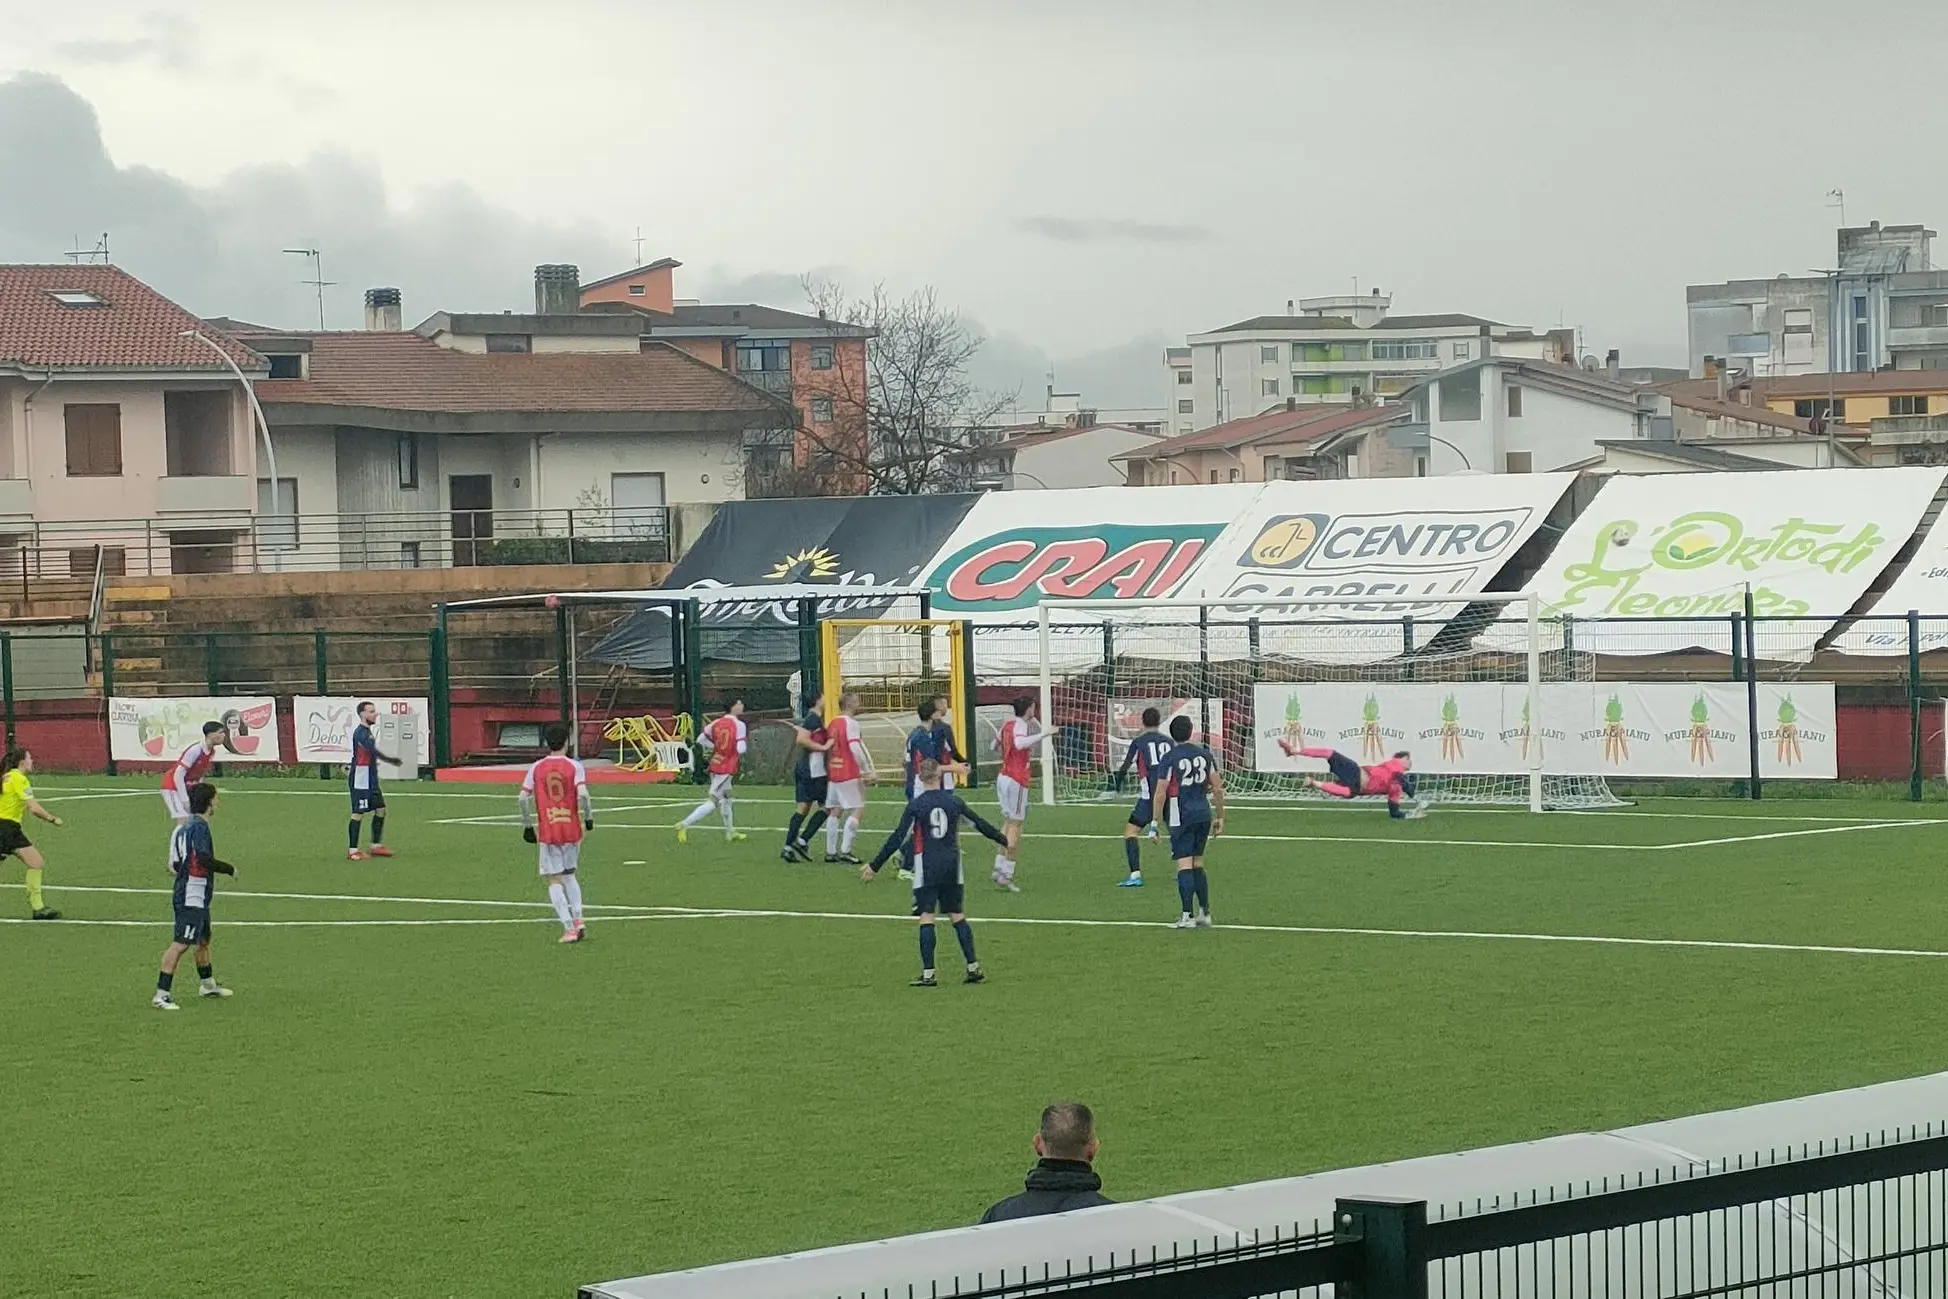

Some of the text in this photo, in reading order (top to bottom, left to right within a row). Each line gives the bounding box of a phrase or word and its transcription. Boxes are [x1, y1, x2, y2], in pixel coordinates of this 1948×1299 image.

[1322, 519, 1515, 560] CENTRO
[946, 537, 1205, 601] CRAI
[1223, 577, 1465, 614] CARRELLI
[546, 771, 565, 802] 6
[1178, 756, 1208, 786] 23
[929, 806, 949, 839] 9
